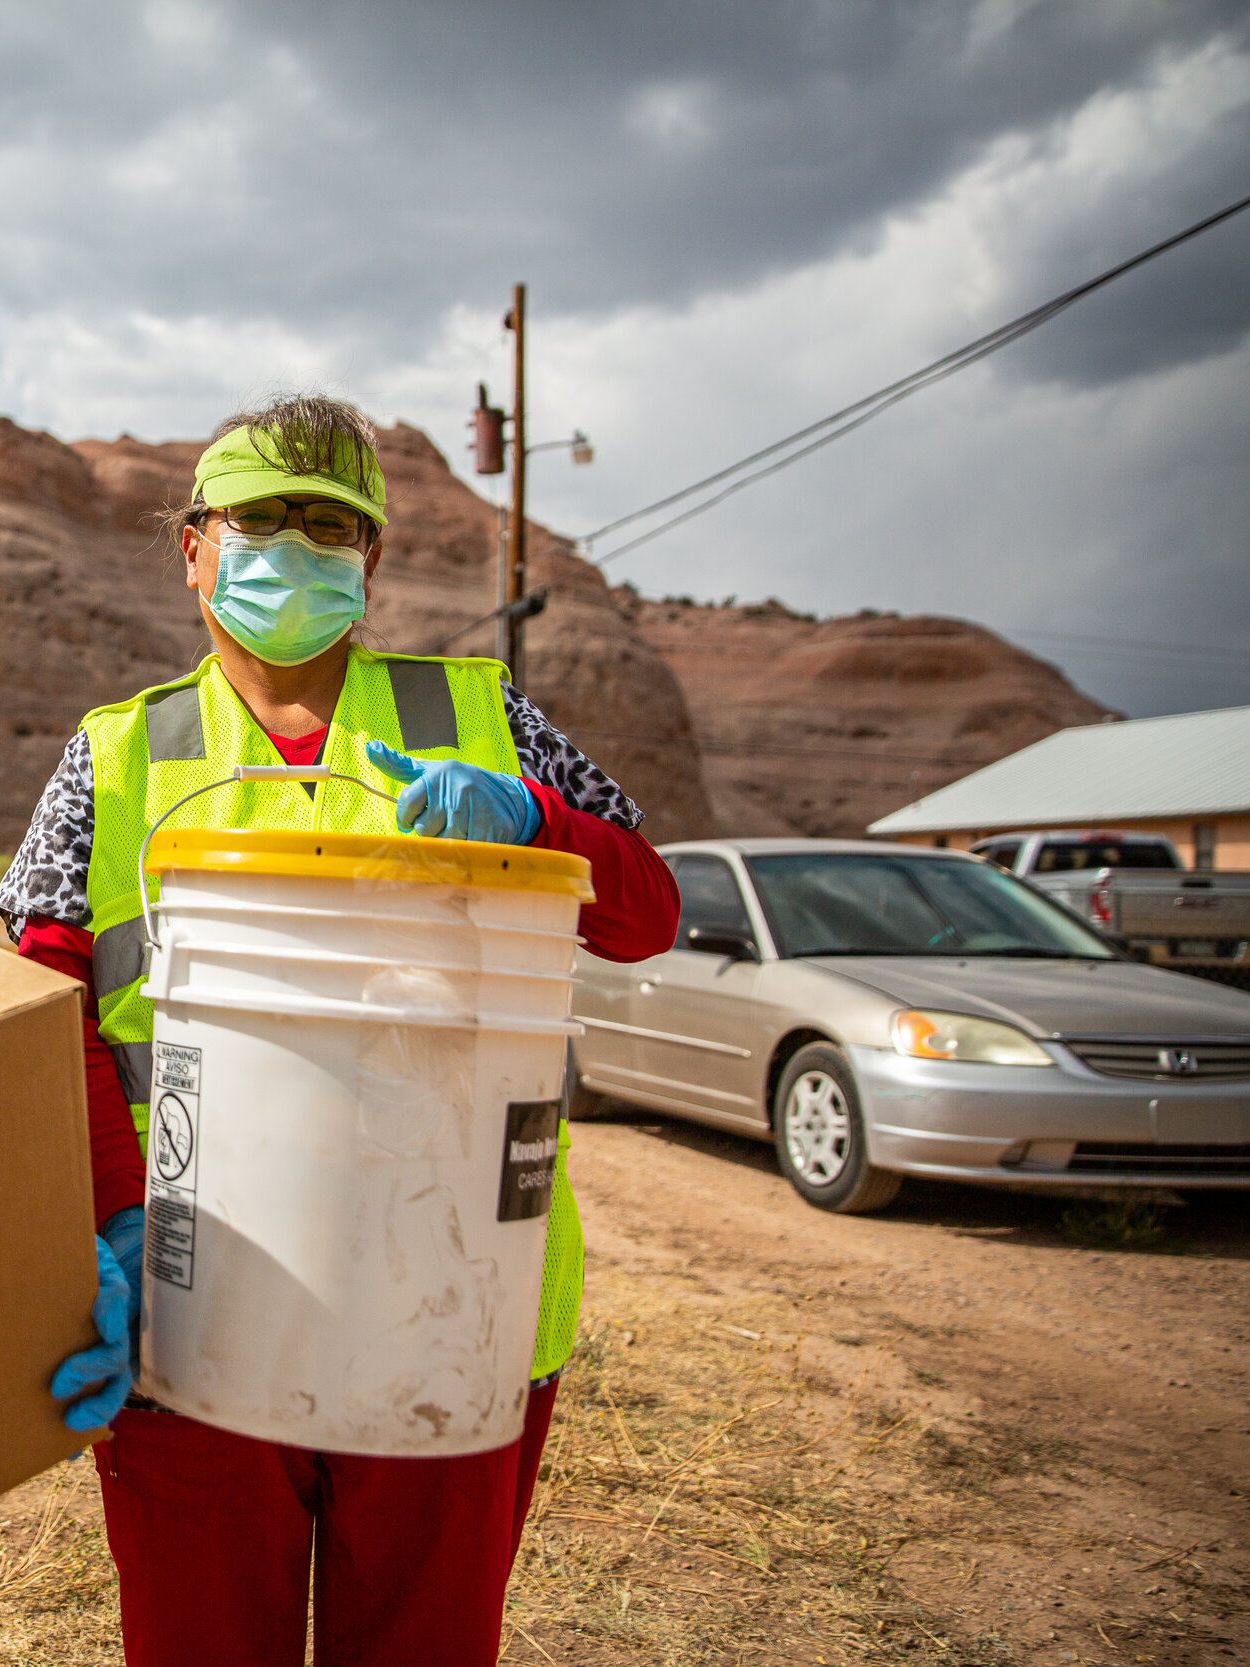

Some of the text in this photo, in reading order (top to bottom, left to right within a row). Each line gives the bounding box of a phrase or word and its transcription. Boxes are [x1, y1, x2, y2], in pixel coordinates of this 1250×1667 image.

[161, 1047, 198, 1062] WARNING
[166, 1060, 189, 1075] AVISO
[518, 1170, 546, 1190] CARES
